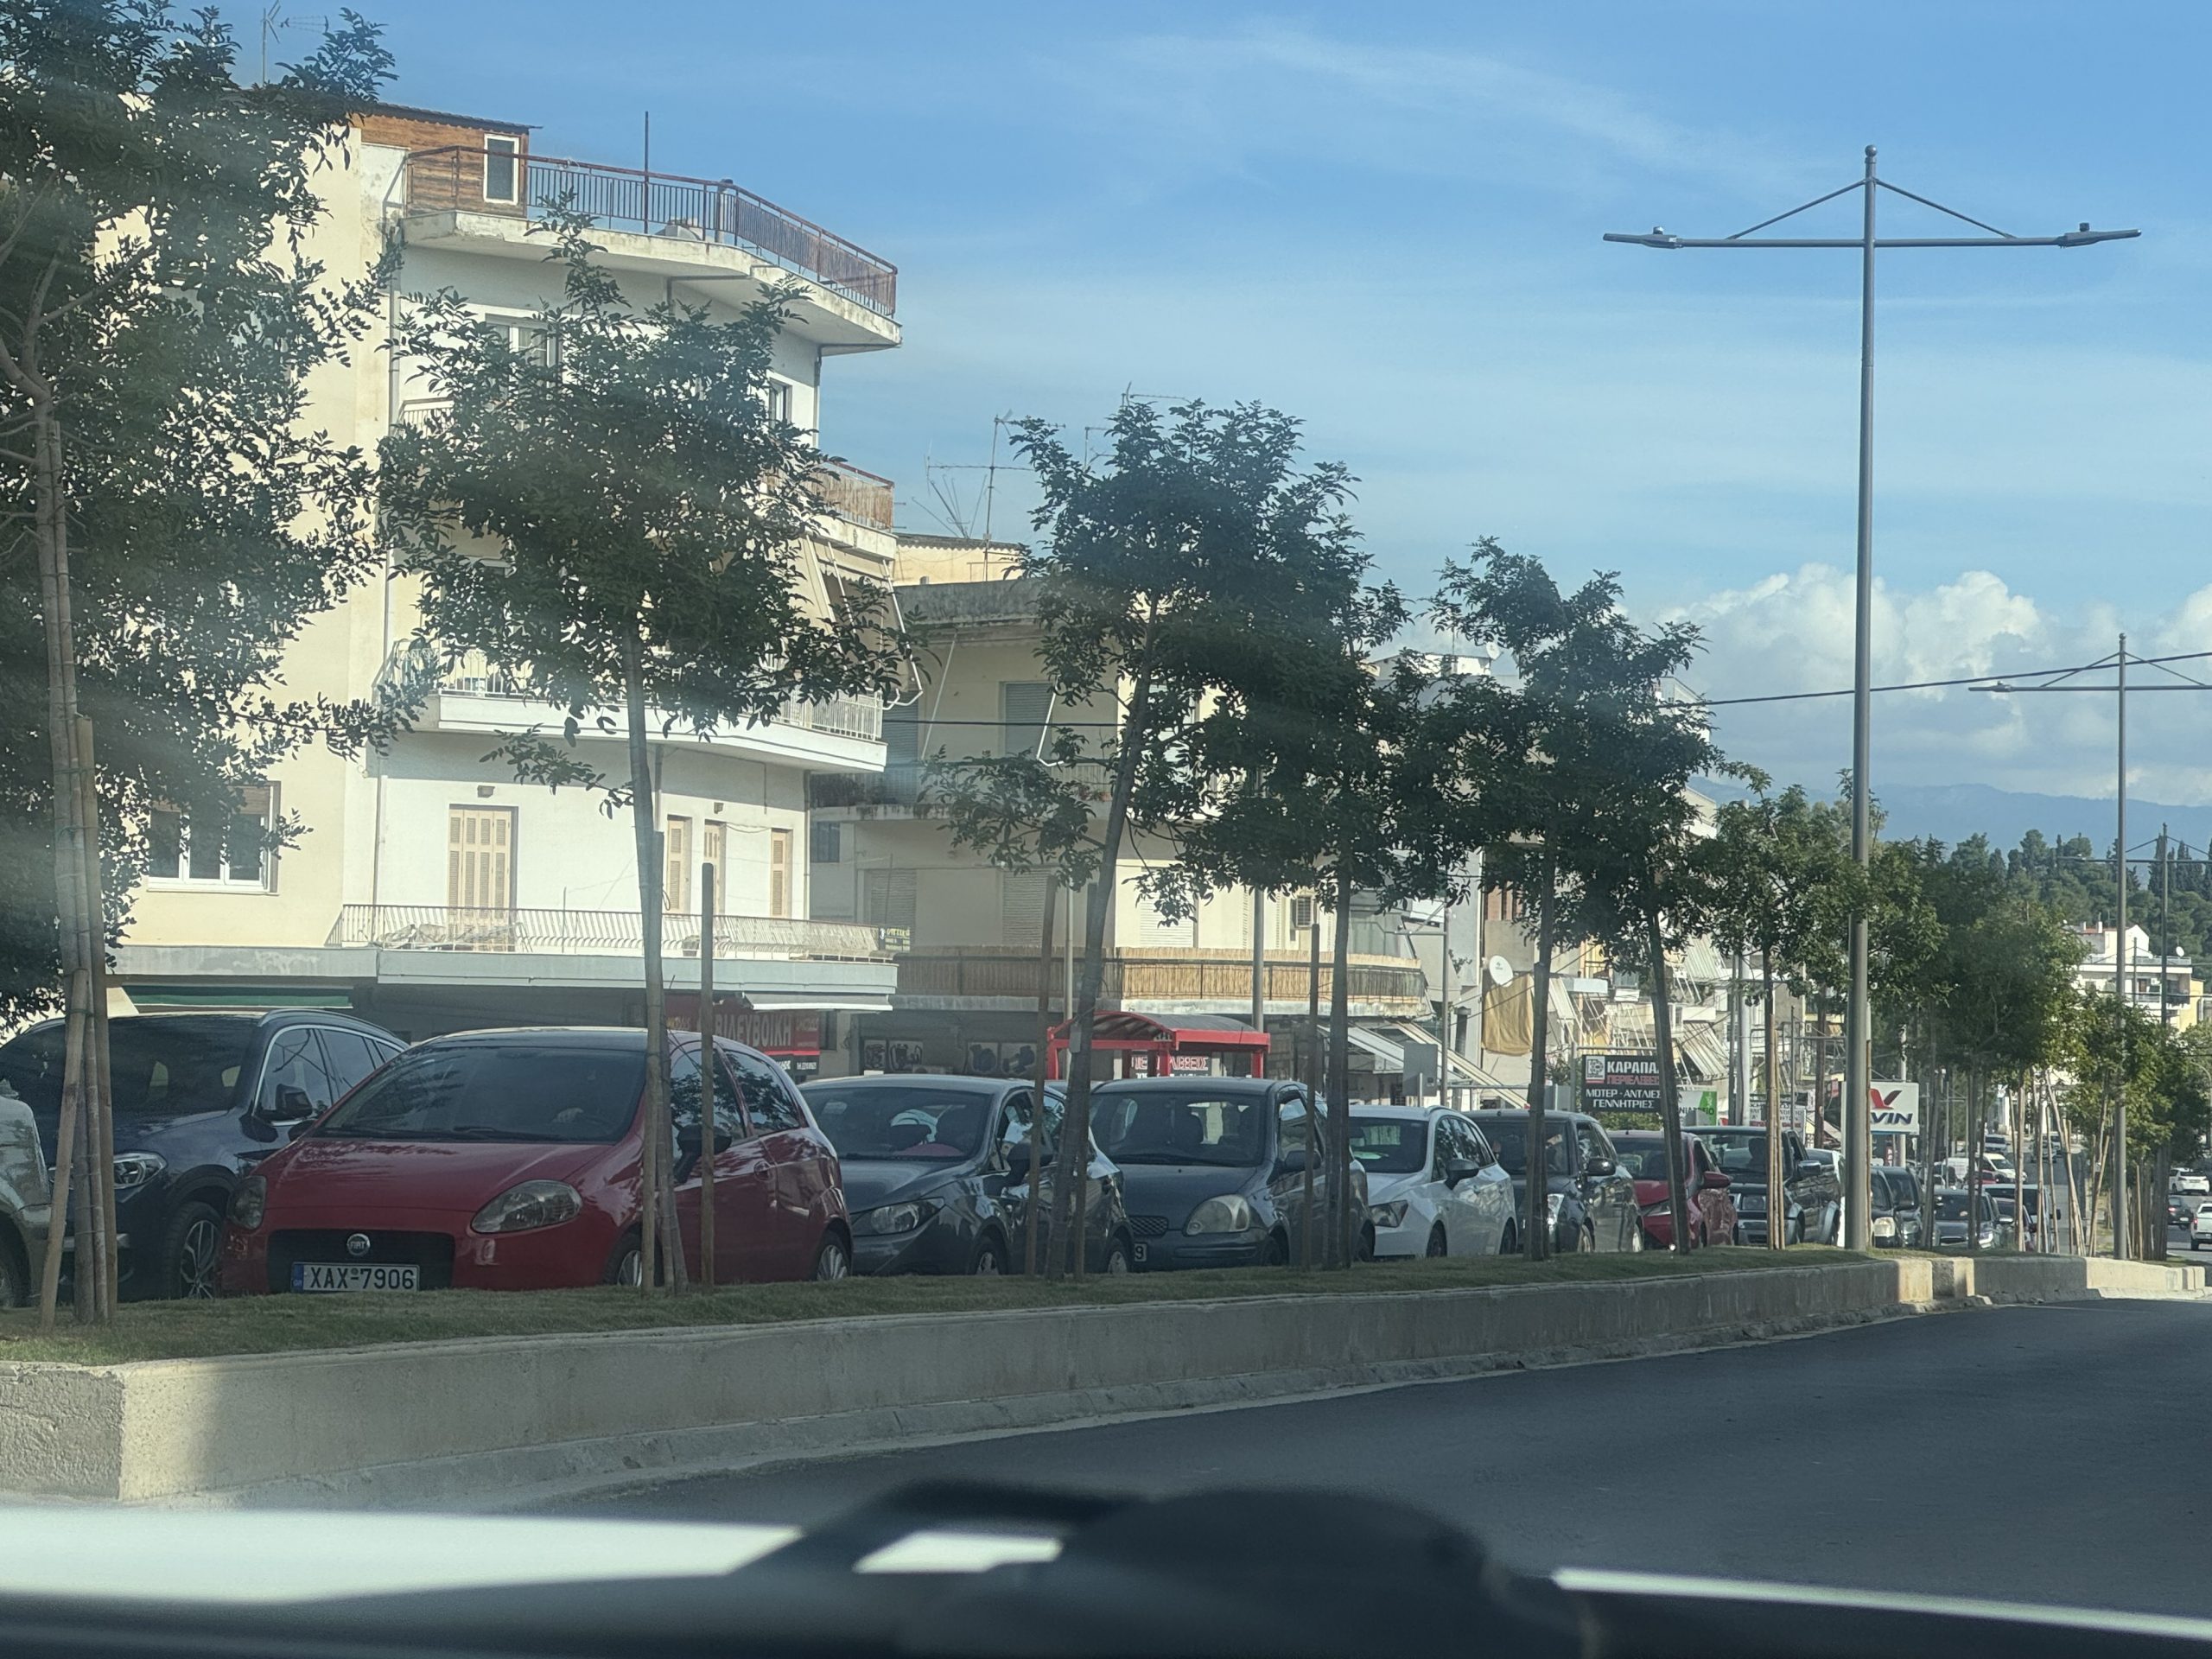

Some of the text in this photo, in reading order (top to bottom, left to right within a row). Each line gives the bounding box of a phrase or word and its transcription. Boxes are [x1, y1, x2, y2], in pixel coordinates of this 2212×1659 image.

[1607, 1061, 1659, 1074] ΚΑΡΑΠΑ
[1592, 1099, 1655, 1109] ΓΕΝΝΗΤΡΙΕΣ
[1871, 1112, 1913, 1125] VIN
